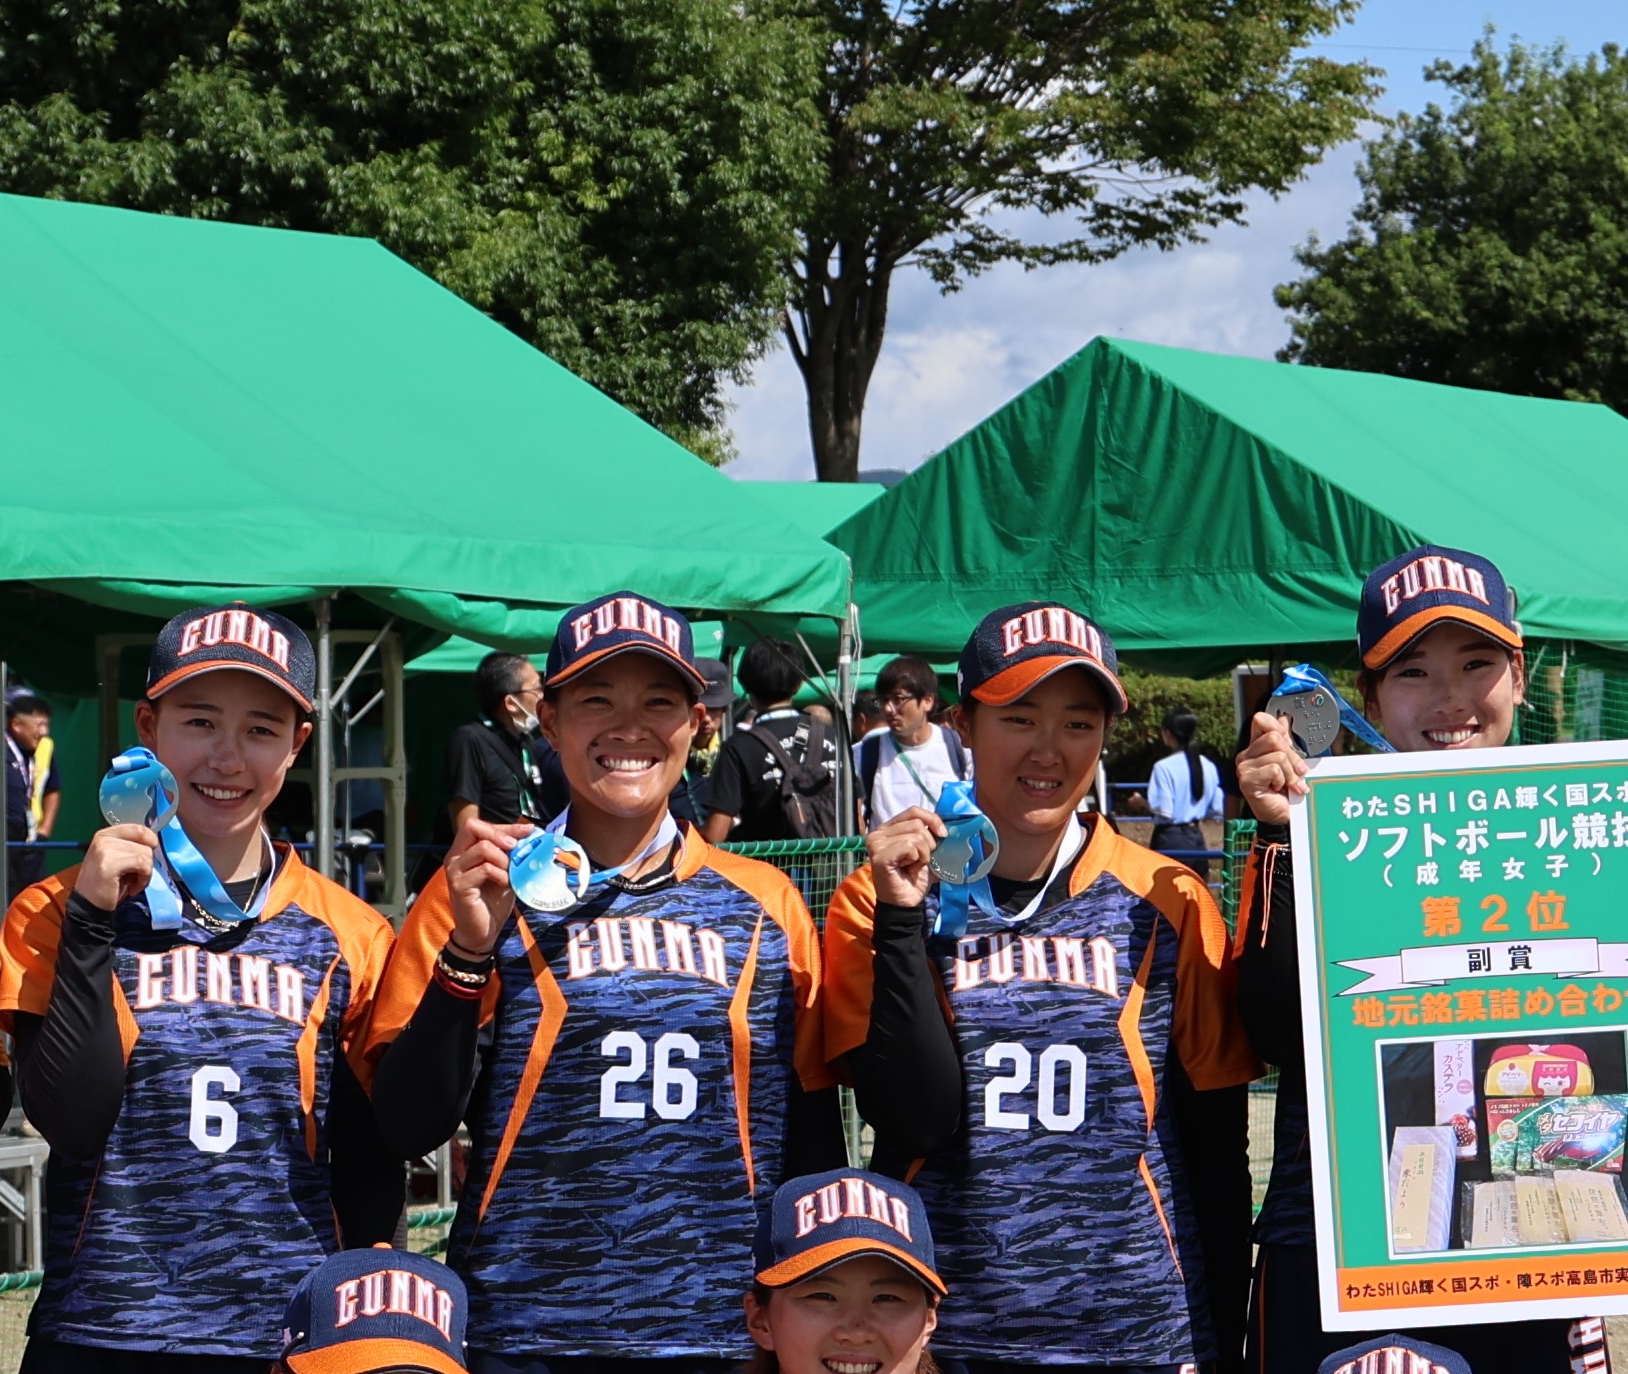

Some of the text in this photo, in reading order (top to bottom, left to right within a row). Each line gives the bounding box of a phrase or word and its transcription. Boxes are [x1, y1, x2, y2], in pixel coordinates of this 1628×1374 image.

[1381, 555, 1491, 617] GUNMA
[176, 609, 292, 673] GUNMA
[570, 597, 682, 657] GUNMA
[1002, 606, 1103, 664] GUNMA
[1383, 853, 1602, 888] （成年女子）
[565, 917, 730, 988] GUNMA
[953, 936, 1121, 1000] GUNMA
[1467, 943, 1534, 974] 副賞
[133, 946, 308, 1027] GUNMA
[599, 1031, 700, 1120] 26
[984, 1041, 1087, 1133] 20
[1443, 1055, 1454, 1093] カステラ
[189, 1065, 241, 1153] 6
[795, 1176, 913, 1242] GUNMA
[333, 1269, 454, 1342] GUNMA
